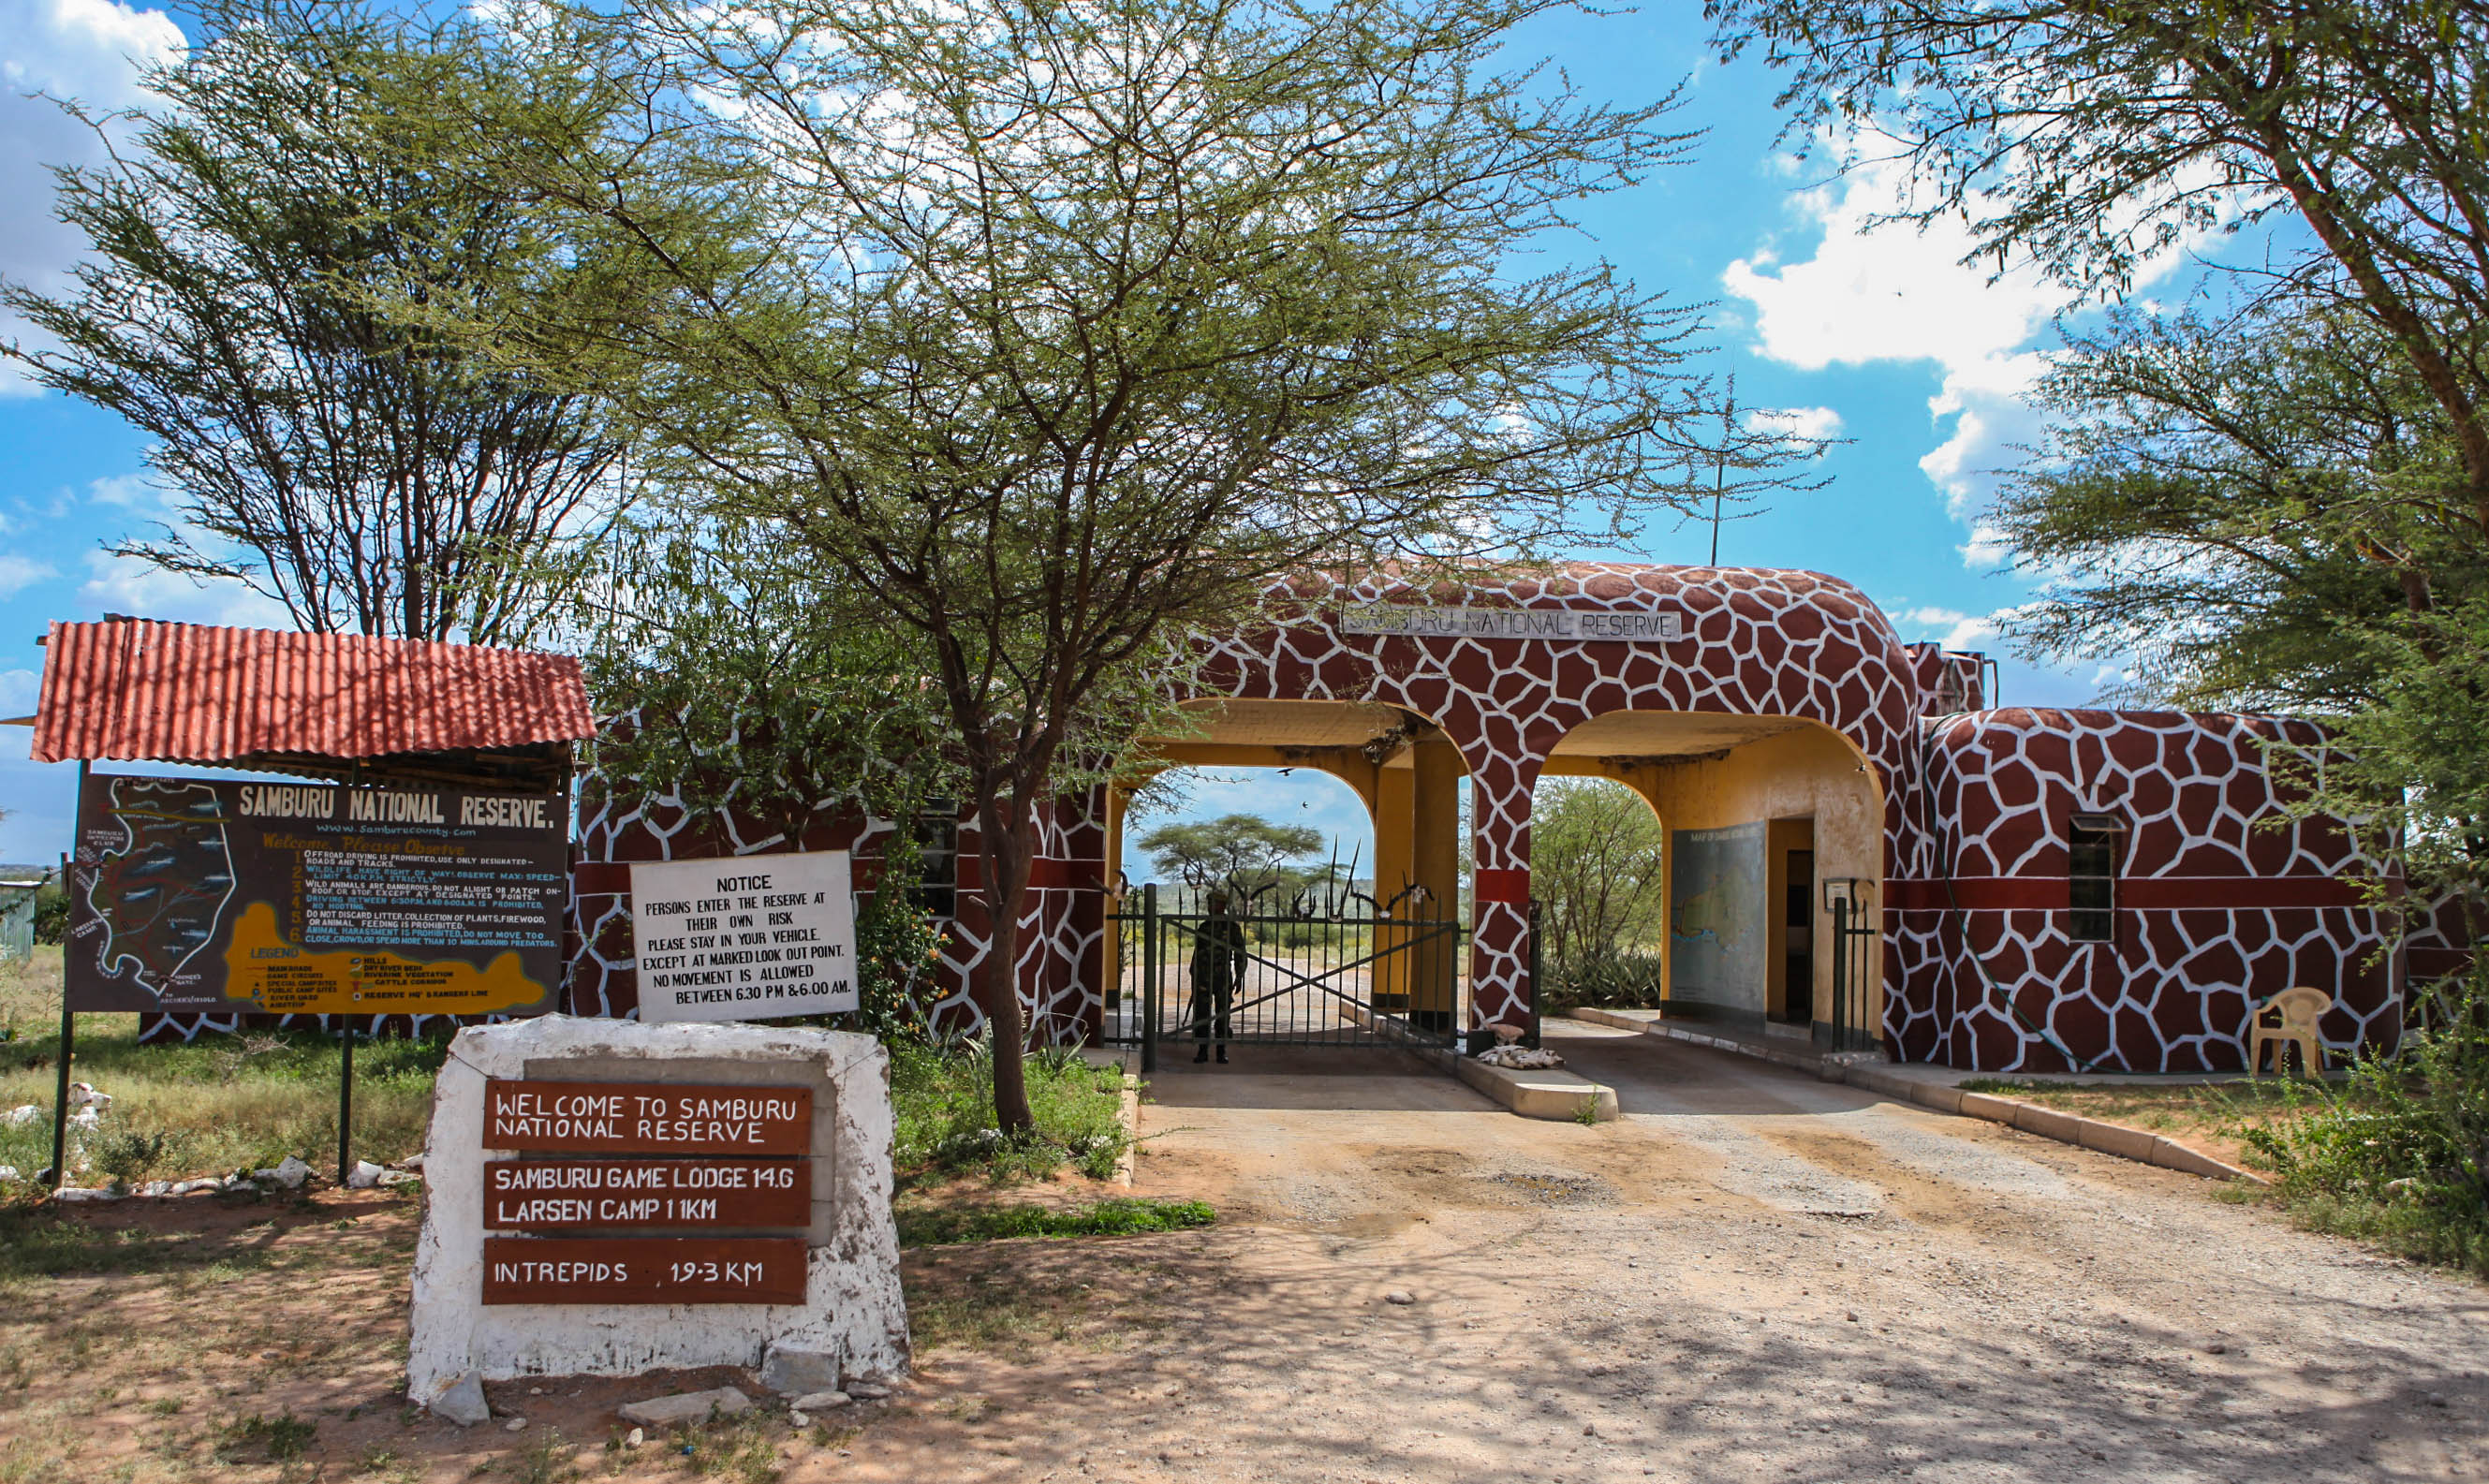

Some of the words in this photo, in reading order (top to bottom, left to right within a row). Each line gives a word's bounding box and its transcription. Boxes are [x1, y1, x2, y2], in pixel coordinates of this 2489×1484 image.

[1465, 611, 1571, 636] NATIONAL
[1583, 614, 1672, 637] RESERVE
[240, 786, 334, 818] SAMBURU
[349, 790, 444, 824] NATIONAL
[461, 796, 554, 829] RESERVE.
[342, 836, 400, 853] Please
[346, 852, 377, 860] DRIVING
[457, 857, 477, 865] ONLY
[358, 860, 396, 868] TRACKS.
[305, 879, 327, 888] WILD
[457, 871, 494, 879] OBSERVE
[716, 874, 773, 892] NOTICE
[306, 894, 344, 903] DRIVING
[348, 896, 387, 904] BETWEEN
[645, 901, 691, 916] PERSONS
[697, 899, 730, 914] ENTER
[738, 896, 758, 910] THE
[763, 892, 807, 908] RESERVE
[814, 892, 825, 904] AT
[306, 909, 318, 918] DO
[338, 911, 372, 919] DISCARD
[361, 919, 399, 928] FEEDING
[685, 916, 717, 932] THEIR
[729, 915, 754, 929] OWN
[768, 911, 793, 926] RISK
[306, 926, 340, 934] ANIMAL
[342, 927, 399, 936] HARASSMENT
[648, 937, 685, 951] PLEASE
[690, 935, 715, 949] STAY
[720, 934, 732, 948] IN
[737, 932, 767, 946] YOUR
[773, 928, 821, 944] VEHICLE.
[251, 948, 300, 959] LEGEND
[643, 954, 686, 970] EXCEPT
[692, 953, 705, 967] AT
[710, 951, 753, 966] MARKED
[755, 949, 782, 963] LOOK
[786, 947, 808, 960] OUT
[810, 945, 845, 960] POINT.
[654, 974, 670, 988] NO
[672, 970, 733, 986] MOVEMENT
[740, 968, 752, 982] IS
[759, 964, 814, 981] ALLOWED
[676, 988, 733, 1005] BETWEEN
[736, 986, 761, 1001] 6.30
[765, 984, 784, 999] PM
[495, 1093, 625, 1119] WELCOME
[634, 1095, 667, 1118] TO
[679, 1096, 797, 1122] SAMBURU
[494, 1118, 625, 1140] NATIONAL
[637, 1121, 766, 1143] RESERVE
[494, 1167, 603, 1191] SAMBURU
[607, 1168, 668, 1189] GAME
[672, 1167, 748, 1189] LODGE
[497, 1199, 593, 1223] LARSEN
[599, 1198, 660, 1221] CAMP
[494, 1262, 628, 1283] INTREPIDS
[726, 1261, 763, 1287] KM
